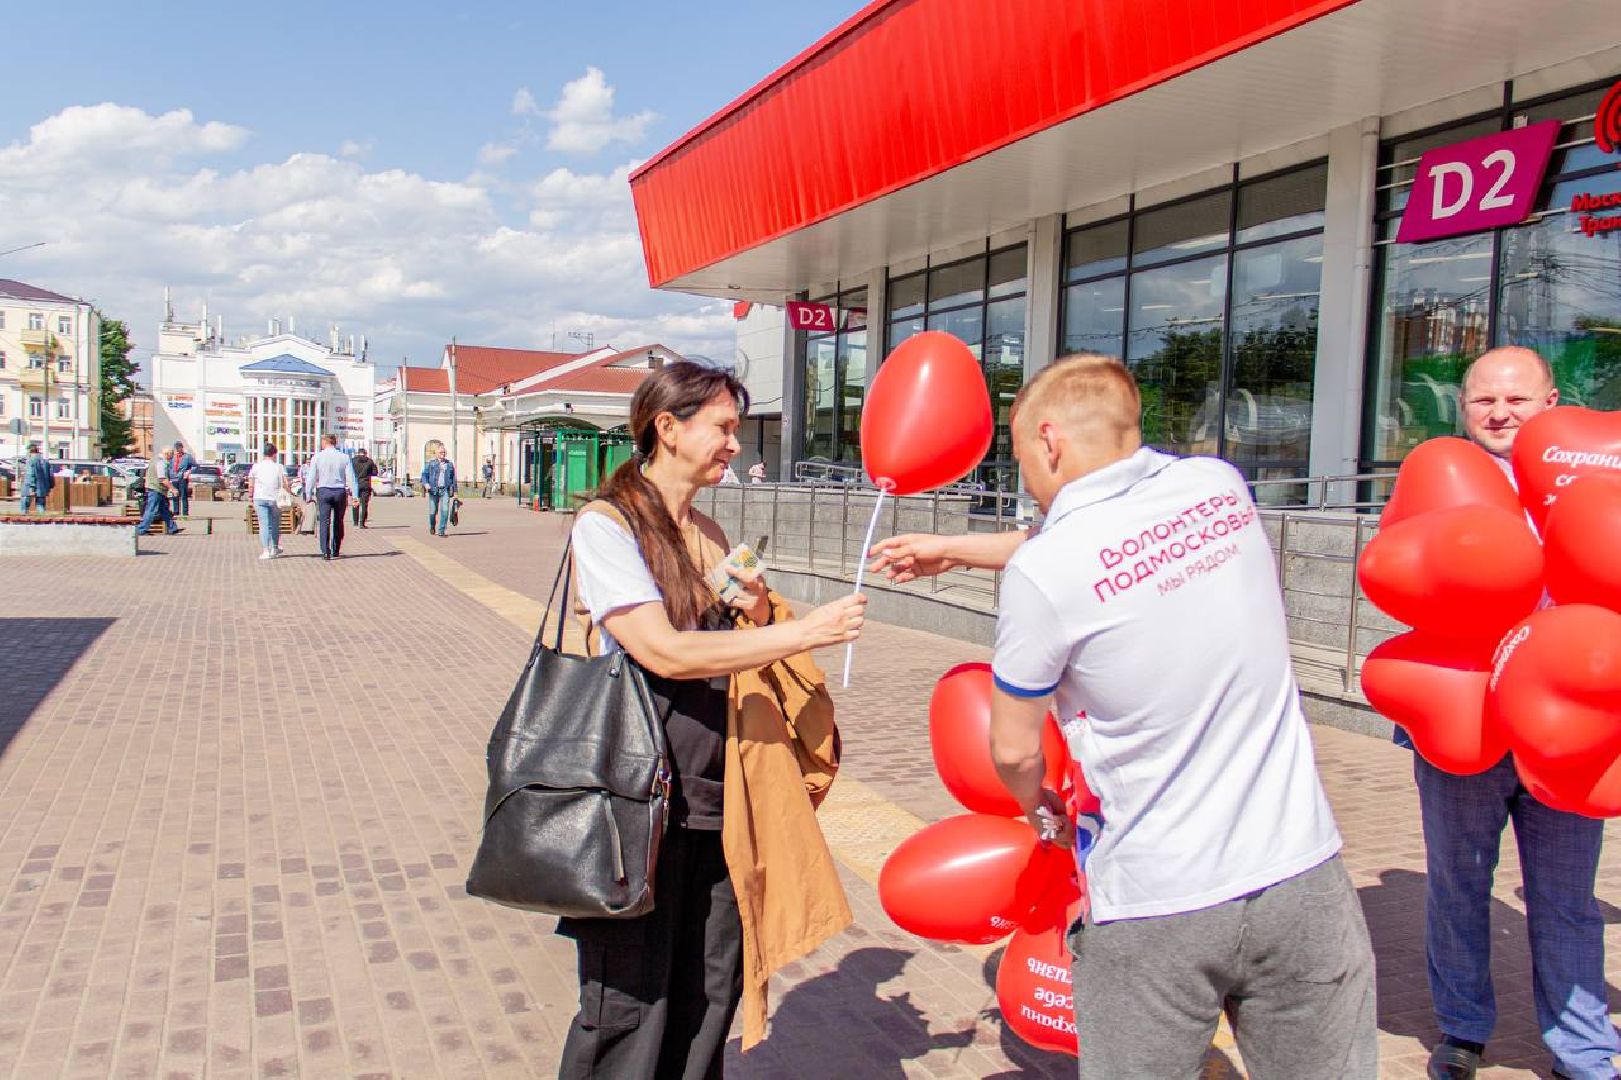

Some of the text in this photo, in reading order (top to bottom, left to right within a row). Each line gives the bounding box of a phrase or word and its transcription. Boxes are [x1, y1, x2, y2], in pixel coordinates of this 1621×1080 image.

[1428, 149, 1516, 220] D2
[798, 307, 826, 327] D2
[1157, 570, 1186, 597] МЫ
